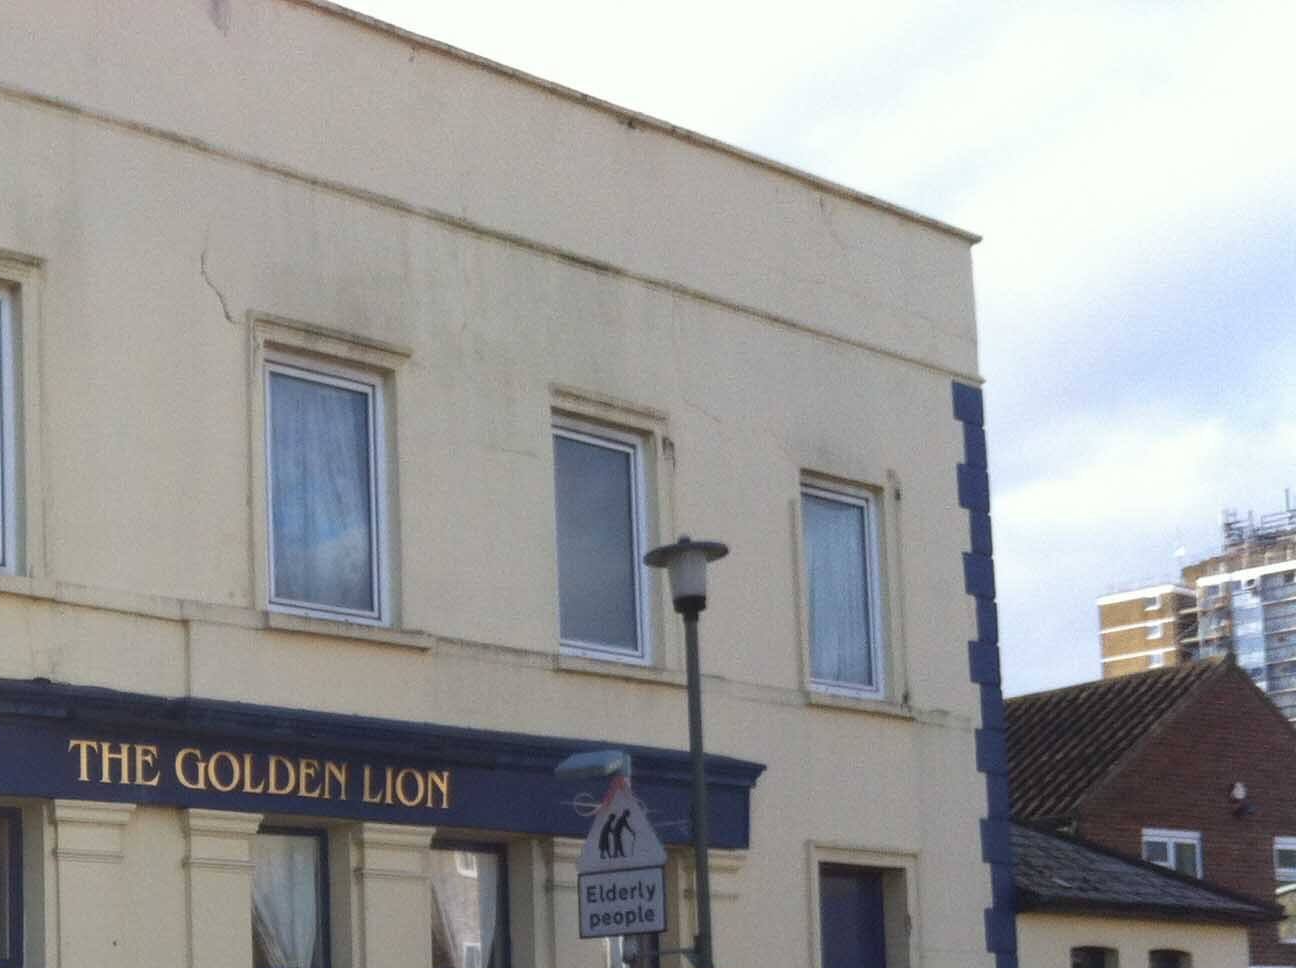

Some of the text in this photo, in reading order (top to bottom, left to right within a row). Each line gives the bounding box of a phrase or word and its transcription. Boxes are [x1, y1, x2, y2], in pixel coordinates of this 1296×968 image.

[69, 738, 451, 809] THE GOLDEN LION
[586, 880, 655, 903] Elderly
[589, 905, 656, 929] people
